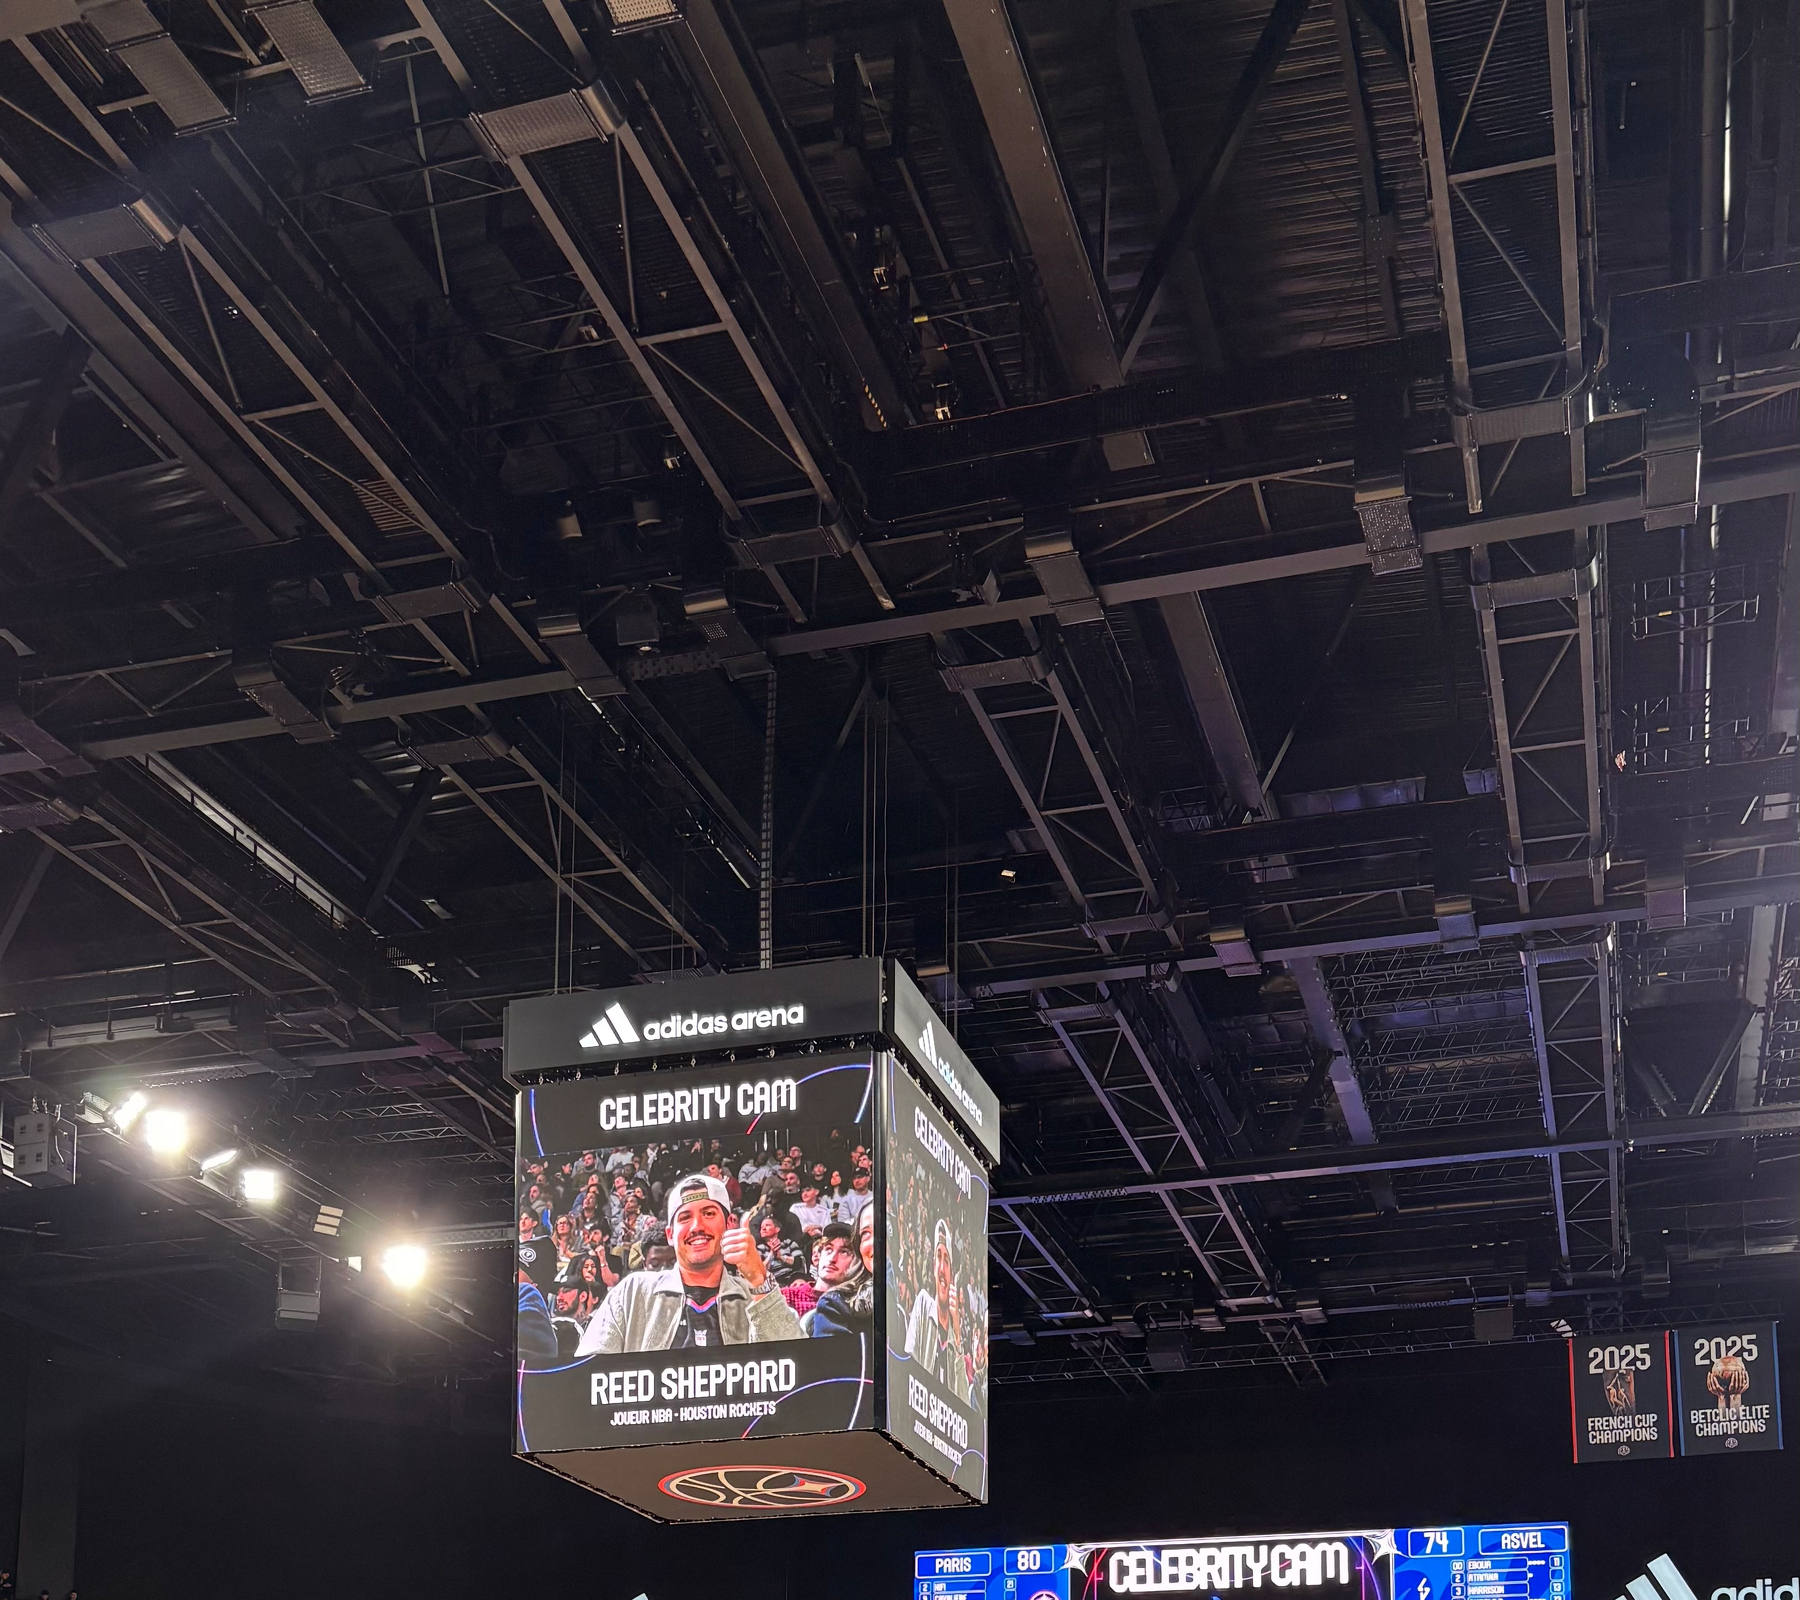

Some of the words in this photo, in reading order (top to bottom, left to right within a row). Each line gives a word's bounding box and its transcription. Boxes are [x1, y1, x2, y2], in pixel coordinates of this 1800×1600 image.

[643, 1011, 728, 1041] adidas
[731, 1004, 804, 1031] arena
[600, 1084, 731, 1131] CELEBRITY
[737, 1077, 797, 1116] CAM
[938, 1056, 962, 1101] adidas
[961, 1089, 983, 1127] arena
[914, 1106, 955, 1178] CELEBRITY
[955, 1154, 971, 1200] CAM
[1588, 1343, 1651, 1375] 2025
[1694, 1334, 1758, 1366] 2025
[590, 1369, 655, 1406] REED
[661, 1358, 796, 1401] SHEPPARD
[610, 1409, 649, 1427] JOUEUR
[651, 1407, 673, 1423] NBA
[680, 1404, 727, 1422] HOUSTON
[729, 1401, 776, 1418] ROCKETS
[908, 1374, 928, 1419] REED
[929, 1393, 968, 1449] SHEPPARD
[1588, 1415, 1632, 1431] FRENCH
[1635, 1413, 1657, 1428] CUP
[1690, 1407, 1737, 1424] BETCLIC
[1739, 1404, 1770, 1420] ÉLITE
[1588, 1427, 1658, 1445] CHAMPIONS
[1695, 1419, 1766, 1437] CHAMPIONS
[1423, 1532, 1449, 1554] 74
[1501, 1532, 1545, 1550] ASVEL
[935, 1557, 972, 1574] PARIS
[1017, 1550, 1040, 1571] 80
[1109, 1544, 1268, 1593] CELEBRITY
[1271, 1541, 1349, 1588] CAM
